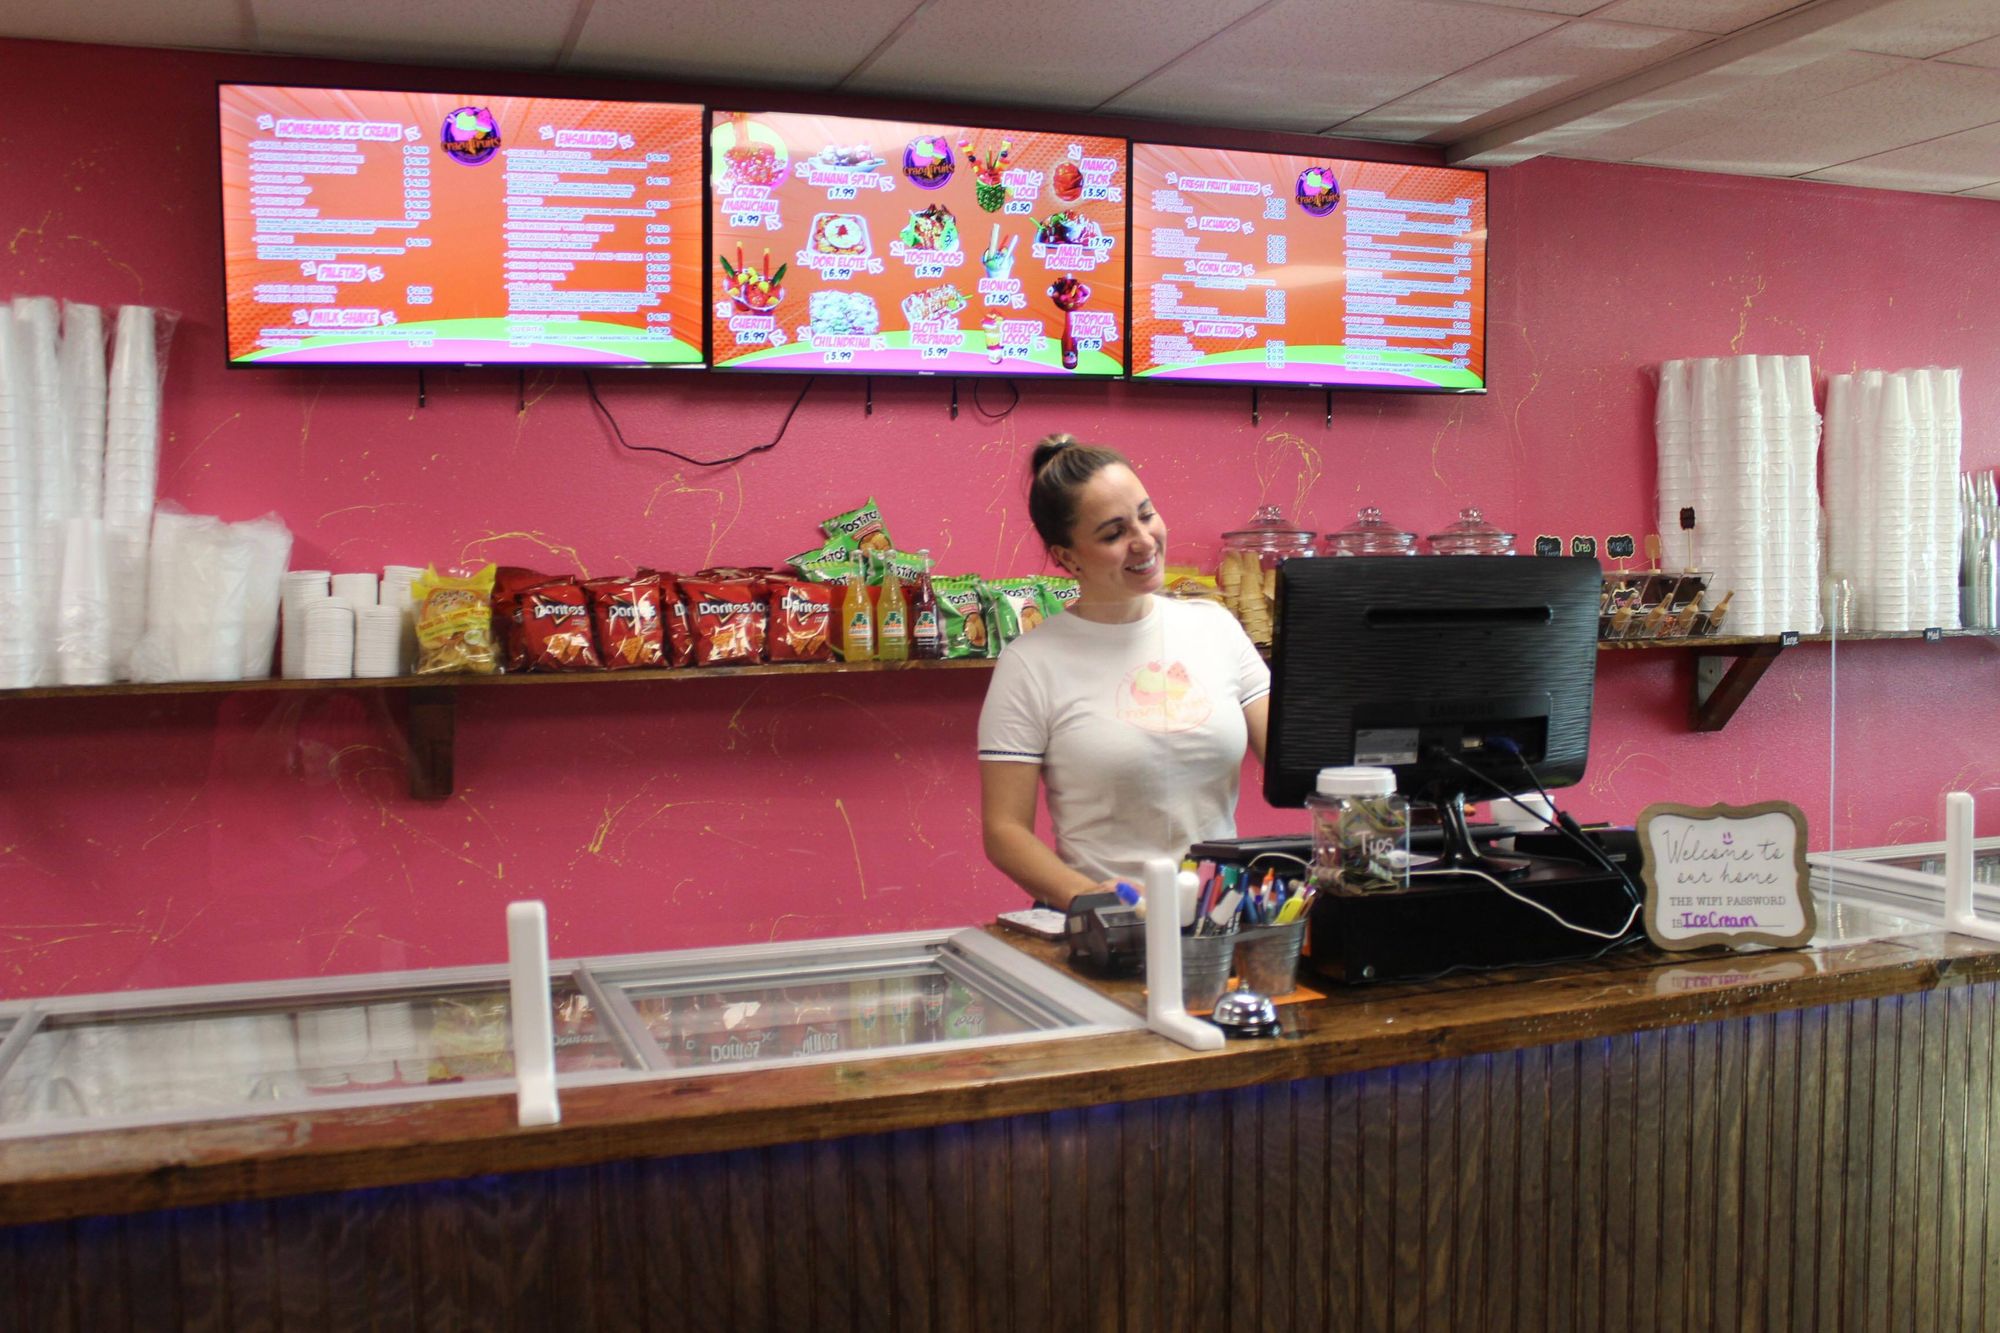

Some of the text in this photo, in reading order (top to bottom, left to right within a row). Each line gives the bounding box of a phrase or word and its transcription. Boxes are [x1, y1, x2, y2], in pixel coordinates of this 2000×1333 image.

[277, 121, 400, 140] HOMEMADE ICE CREAM
[557, 131, 617, 147] ENSALADAS
[1081, 160, 1116, 172] MANGO
[810, 172, 878, 186] BANANA SPLIT
[1086, 173, 1110, 185] FLOR
[1014, 186, 1038, 198] LOCA
[1180, 179, 1259, 193] FRESH FRUIT WATERS
[734, 187, 768, 199] CRAZY
[722, 200, 777, 212] MARUCHAN
[1200, 218, 1238, 230] LICUADOS
[904, 251, 963, 265] TOSTILOCOS
[1057, 246, 1082, 257] MAXI
[812, 255, 866, 269] DORI ELOTE
[1045, 256, 1095, 269] DORIELOTE
[1198, 262, 1242, 275] CORN CUPS
[318, 265, 366, 281] PALETAS
[979, 280, 1020, 292] BIONICO
[311, 310, 378, 326] MILK SHAKE
[730, 317, 774, 330] GUERITA
[1074, 313, 1114, 326] TROPICAL
[912, 321, 941, 332] ELOTE
[1002, 321, 1041, 333] CHEETOS
[1072, 324, 1102, 336] PUNCH
[1197, 324, 1243, 336] ANY EXTRAS
[812, 336, 871, 348] CHILINDRINA
[911, 332, 963, 345] PREPARADO
[1002, 333, 1032, 344] LOCOS
[1574, 541, 1591, 553] Oreo
[534, 604, 586, 619] Doritos
[699, 602, 750, 615] Doritos
[1356, 830, 1395, 860] Tips
[1662, 825, 1784, 864] Welcome to
[1677, 863, 1779, 885] our home
[1669, 895, 1787, 906] THE WIFI PASSWORD
[1672, 911, 1759, 928] IS IceCream
